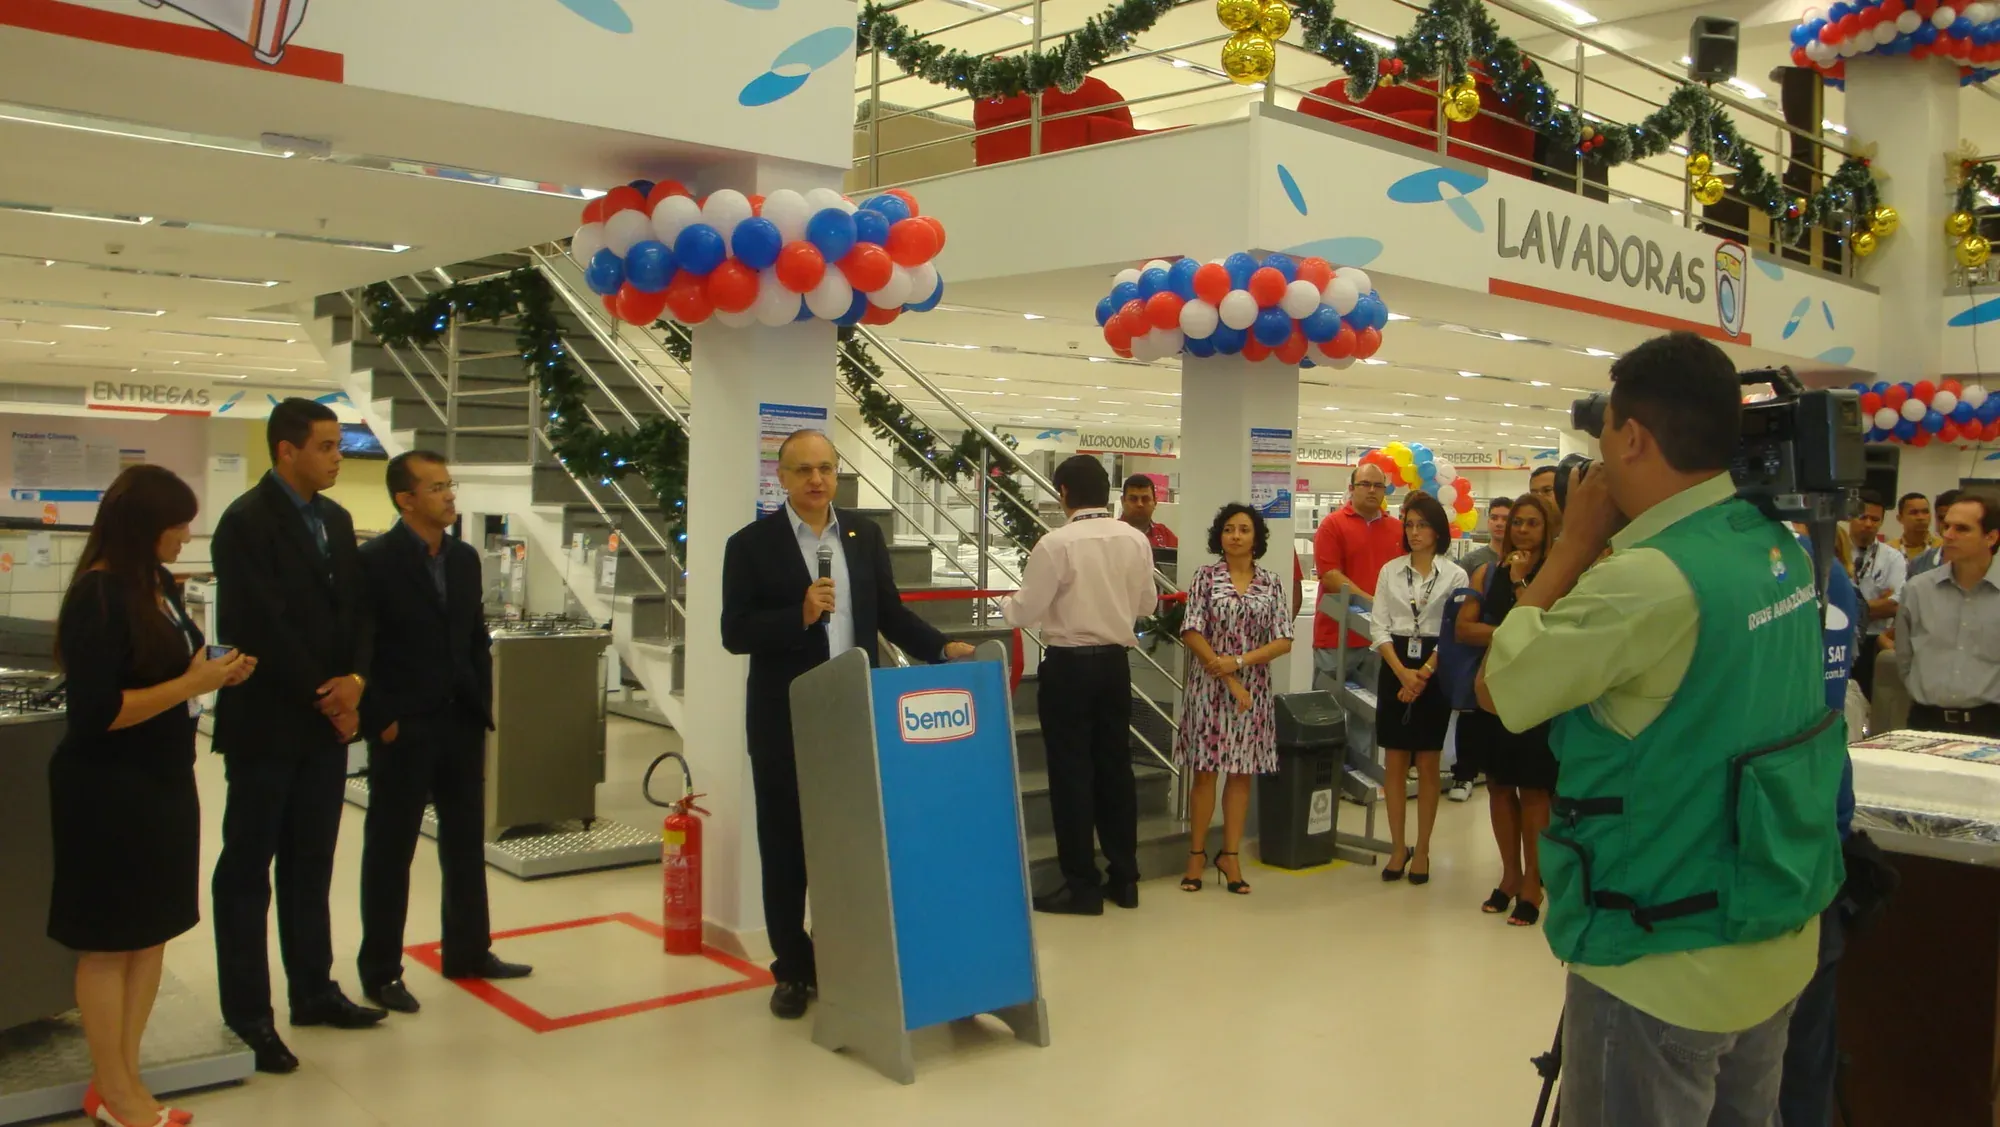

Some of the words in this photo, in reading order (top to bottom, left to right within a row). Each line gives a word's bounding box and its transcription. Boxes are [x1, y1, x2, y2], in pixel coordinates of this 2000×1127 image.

[1497, 197, 1706, 304] LAVADORAS
[93, 380, 210, 406] ENTREGAS
[1079, 434, 1150, 449] MICROONDAS
[1296, 447, 1343, 461] ELADEIRAS
[1773, 583, 1817, 618] AMAZÔNIC
[1828, 645, 1847, 664] SAT
[905, 702, 970, 731] bemol
